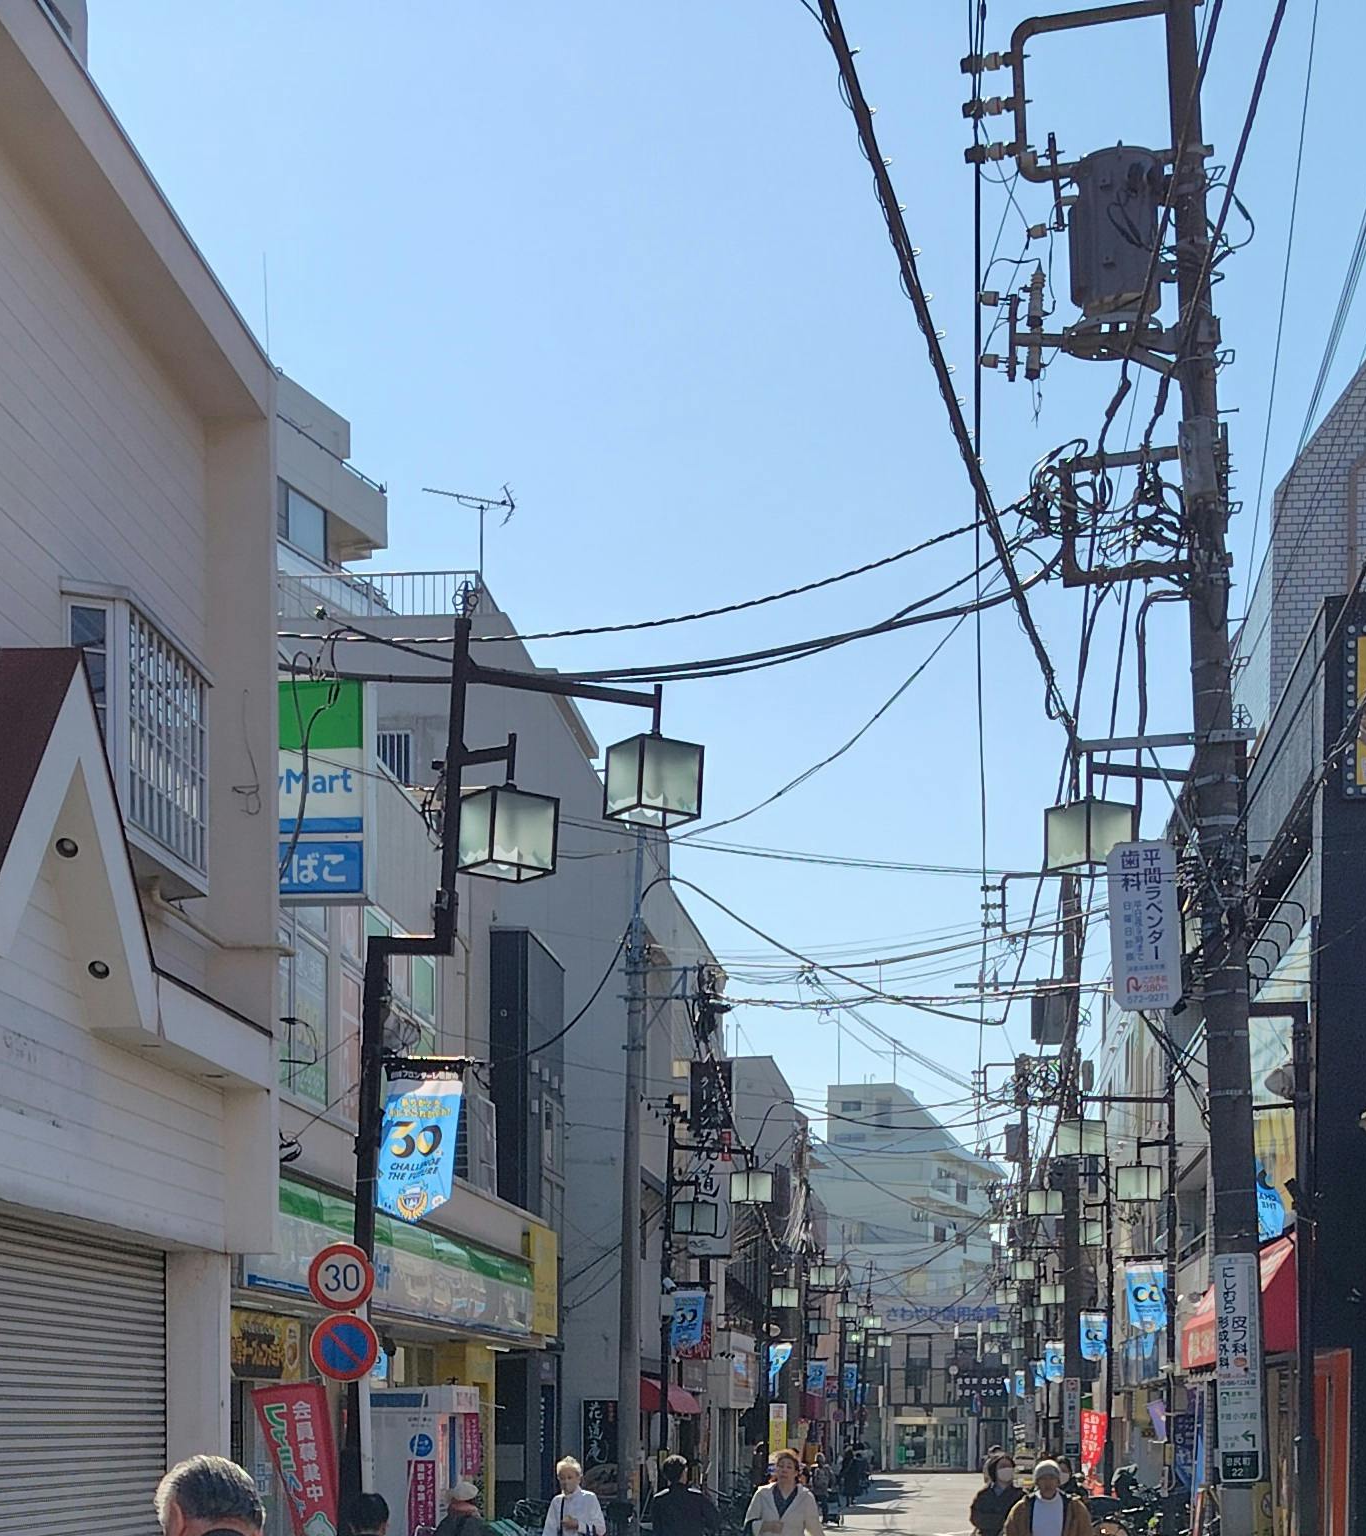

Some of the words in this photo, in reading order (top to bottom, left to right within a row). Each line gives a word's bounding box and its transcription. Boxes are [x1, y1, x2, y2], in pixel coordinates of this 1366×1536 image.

[1120, 850, 1141, 892] 歯科
[1142, 849, 1164, 960] 平間ラベンダー
[390, 1121, 443, 1159] 30
[324, 1263, 361, 1293] 30
[1231, 1468, 1244, 1477] 22
